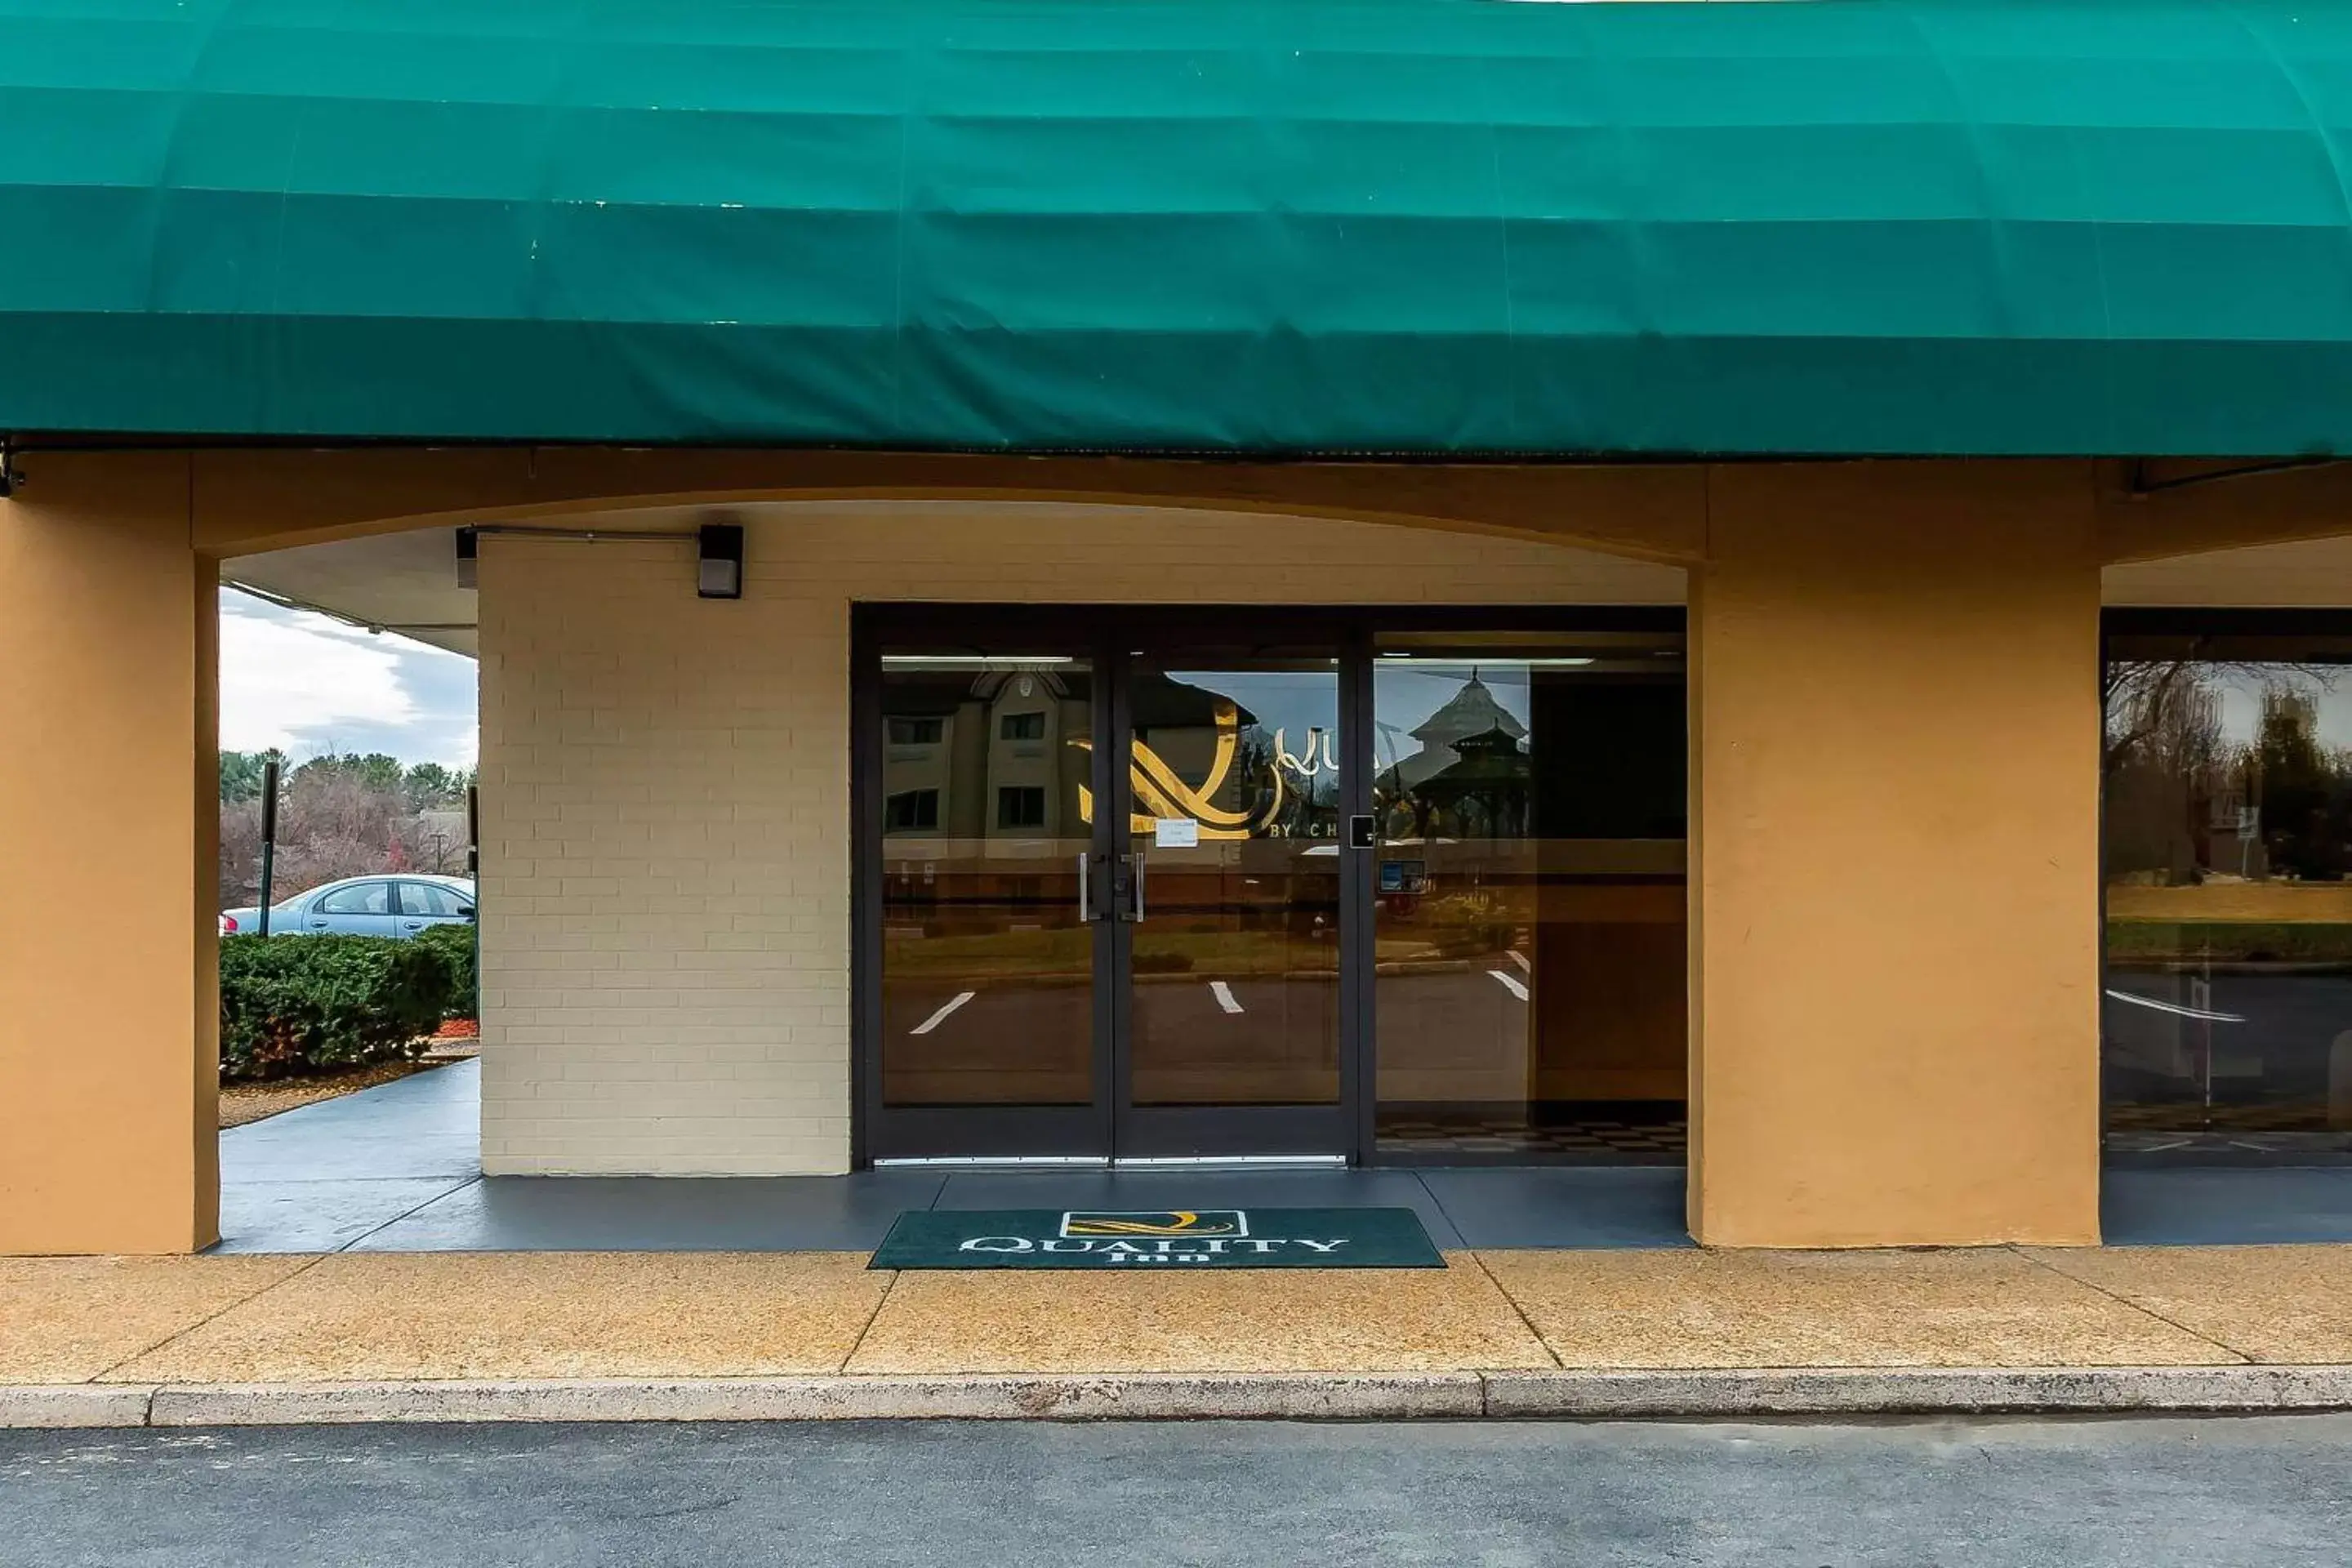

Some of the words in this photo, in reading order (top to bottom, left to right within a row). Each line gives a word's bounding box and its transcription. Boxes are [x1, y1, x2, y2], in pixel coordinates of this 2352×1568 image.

[1271, 823, 1291, 837] BY
[959, 1236, 1349, 1254] QUALITY
[1106, 1252, 1209, 1262] Inn
